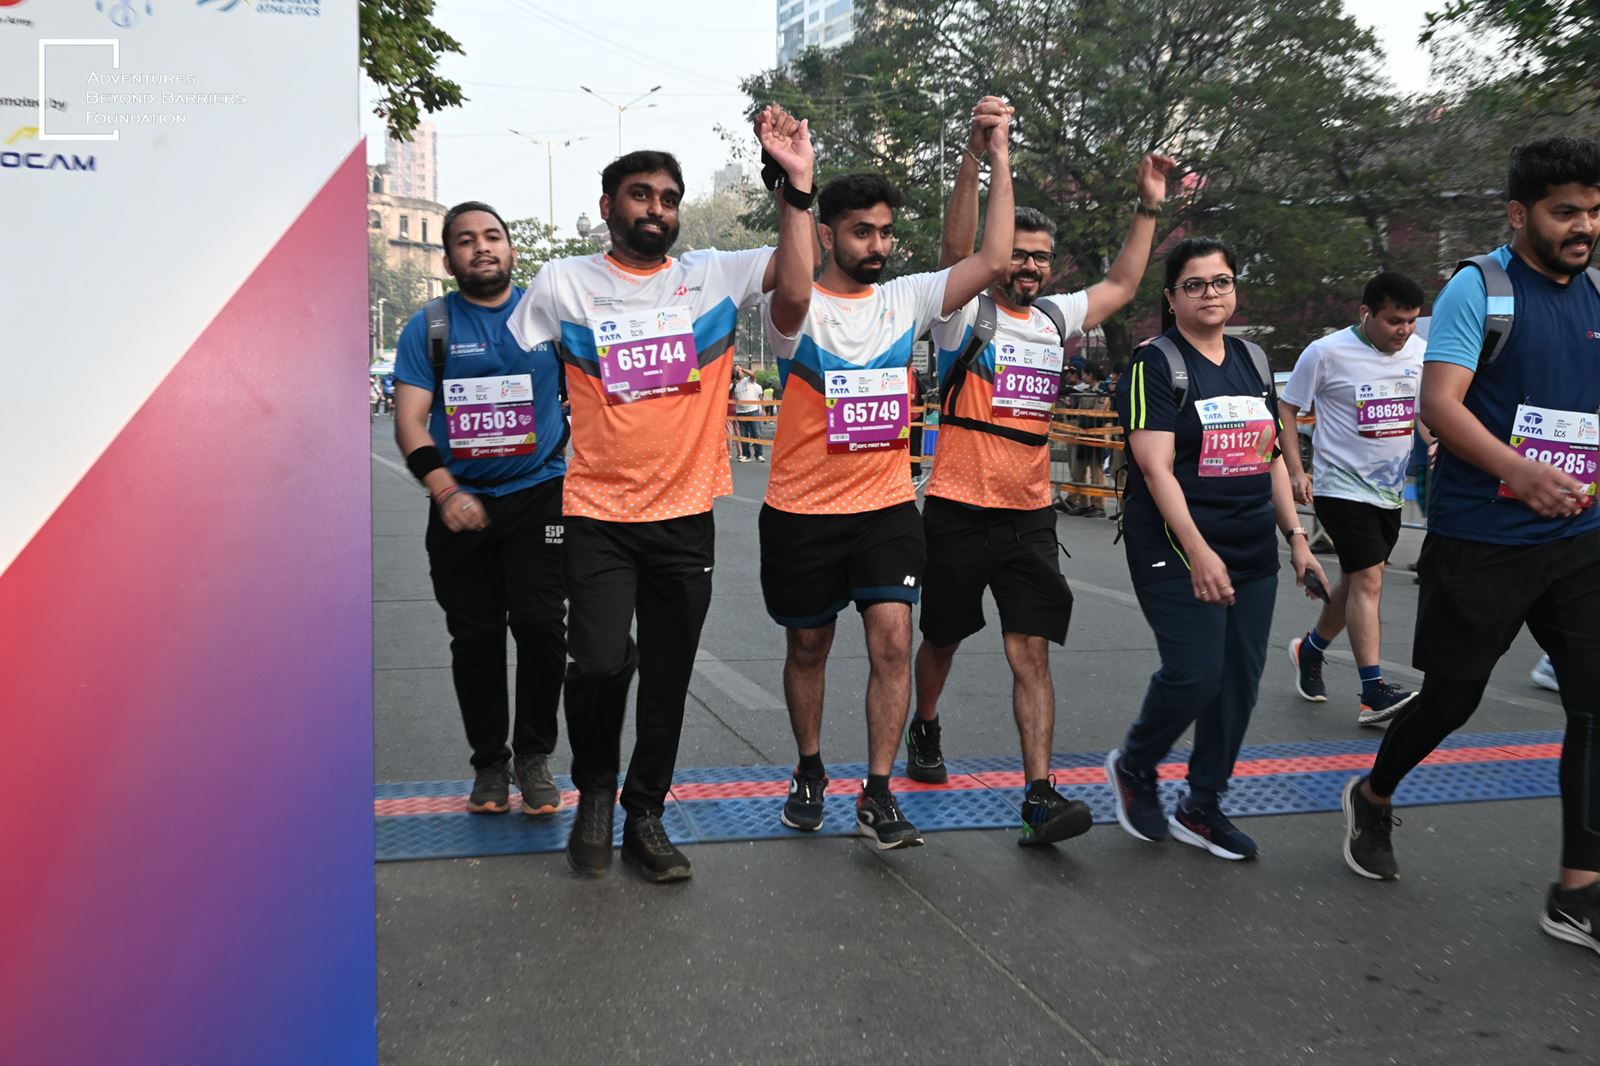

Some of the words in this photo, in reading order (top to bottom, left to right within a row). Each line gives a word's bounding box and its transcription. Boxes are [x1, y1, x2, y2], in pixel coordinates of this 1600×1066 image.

[599, 333, 622, 342] TATA
[617, 341, 687, 371] 65744
[999, 355, 1017, 363] TATA
[1006, 373, 1051, 395] 87832
[842, 400, 900, 423] 65749
[1367, 403, 1405, 419] 88628
[460, 410, 517, 431] 87503
[1518, 425, 1543, 435] TATA
[1553, 428, 1567, 438] tcs
[1210, 431, 1260, 450] 131127
[545, 525, 565, 538] SP
